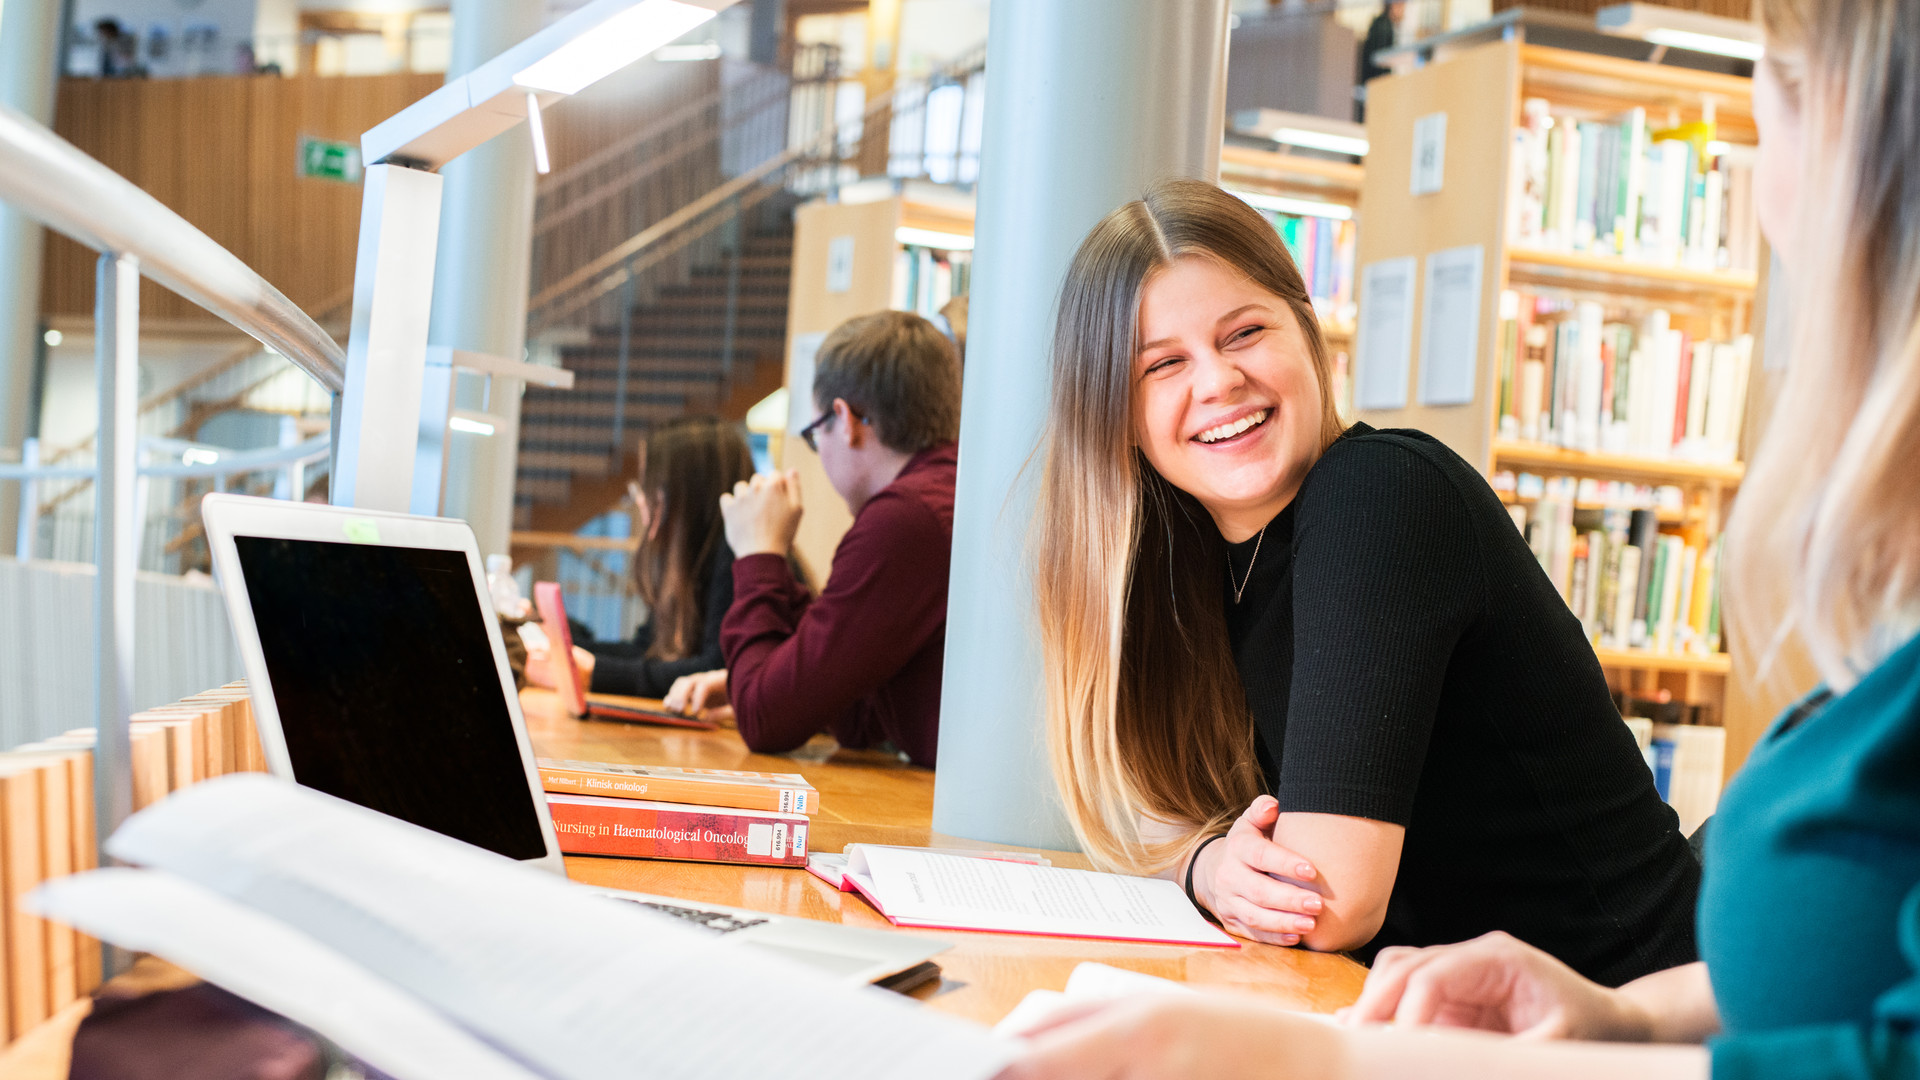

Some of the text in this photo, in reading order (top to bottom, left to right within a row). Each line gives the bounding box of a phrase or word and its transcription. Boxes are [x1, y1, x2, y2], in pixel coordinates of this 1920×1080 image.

[586, 778, 613, 790] Klinisk
[614, 782, 648, 794] onkologi
[552, 820, 748, 849] Nursing in Haematological Oncolog
